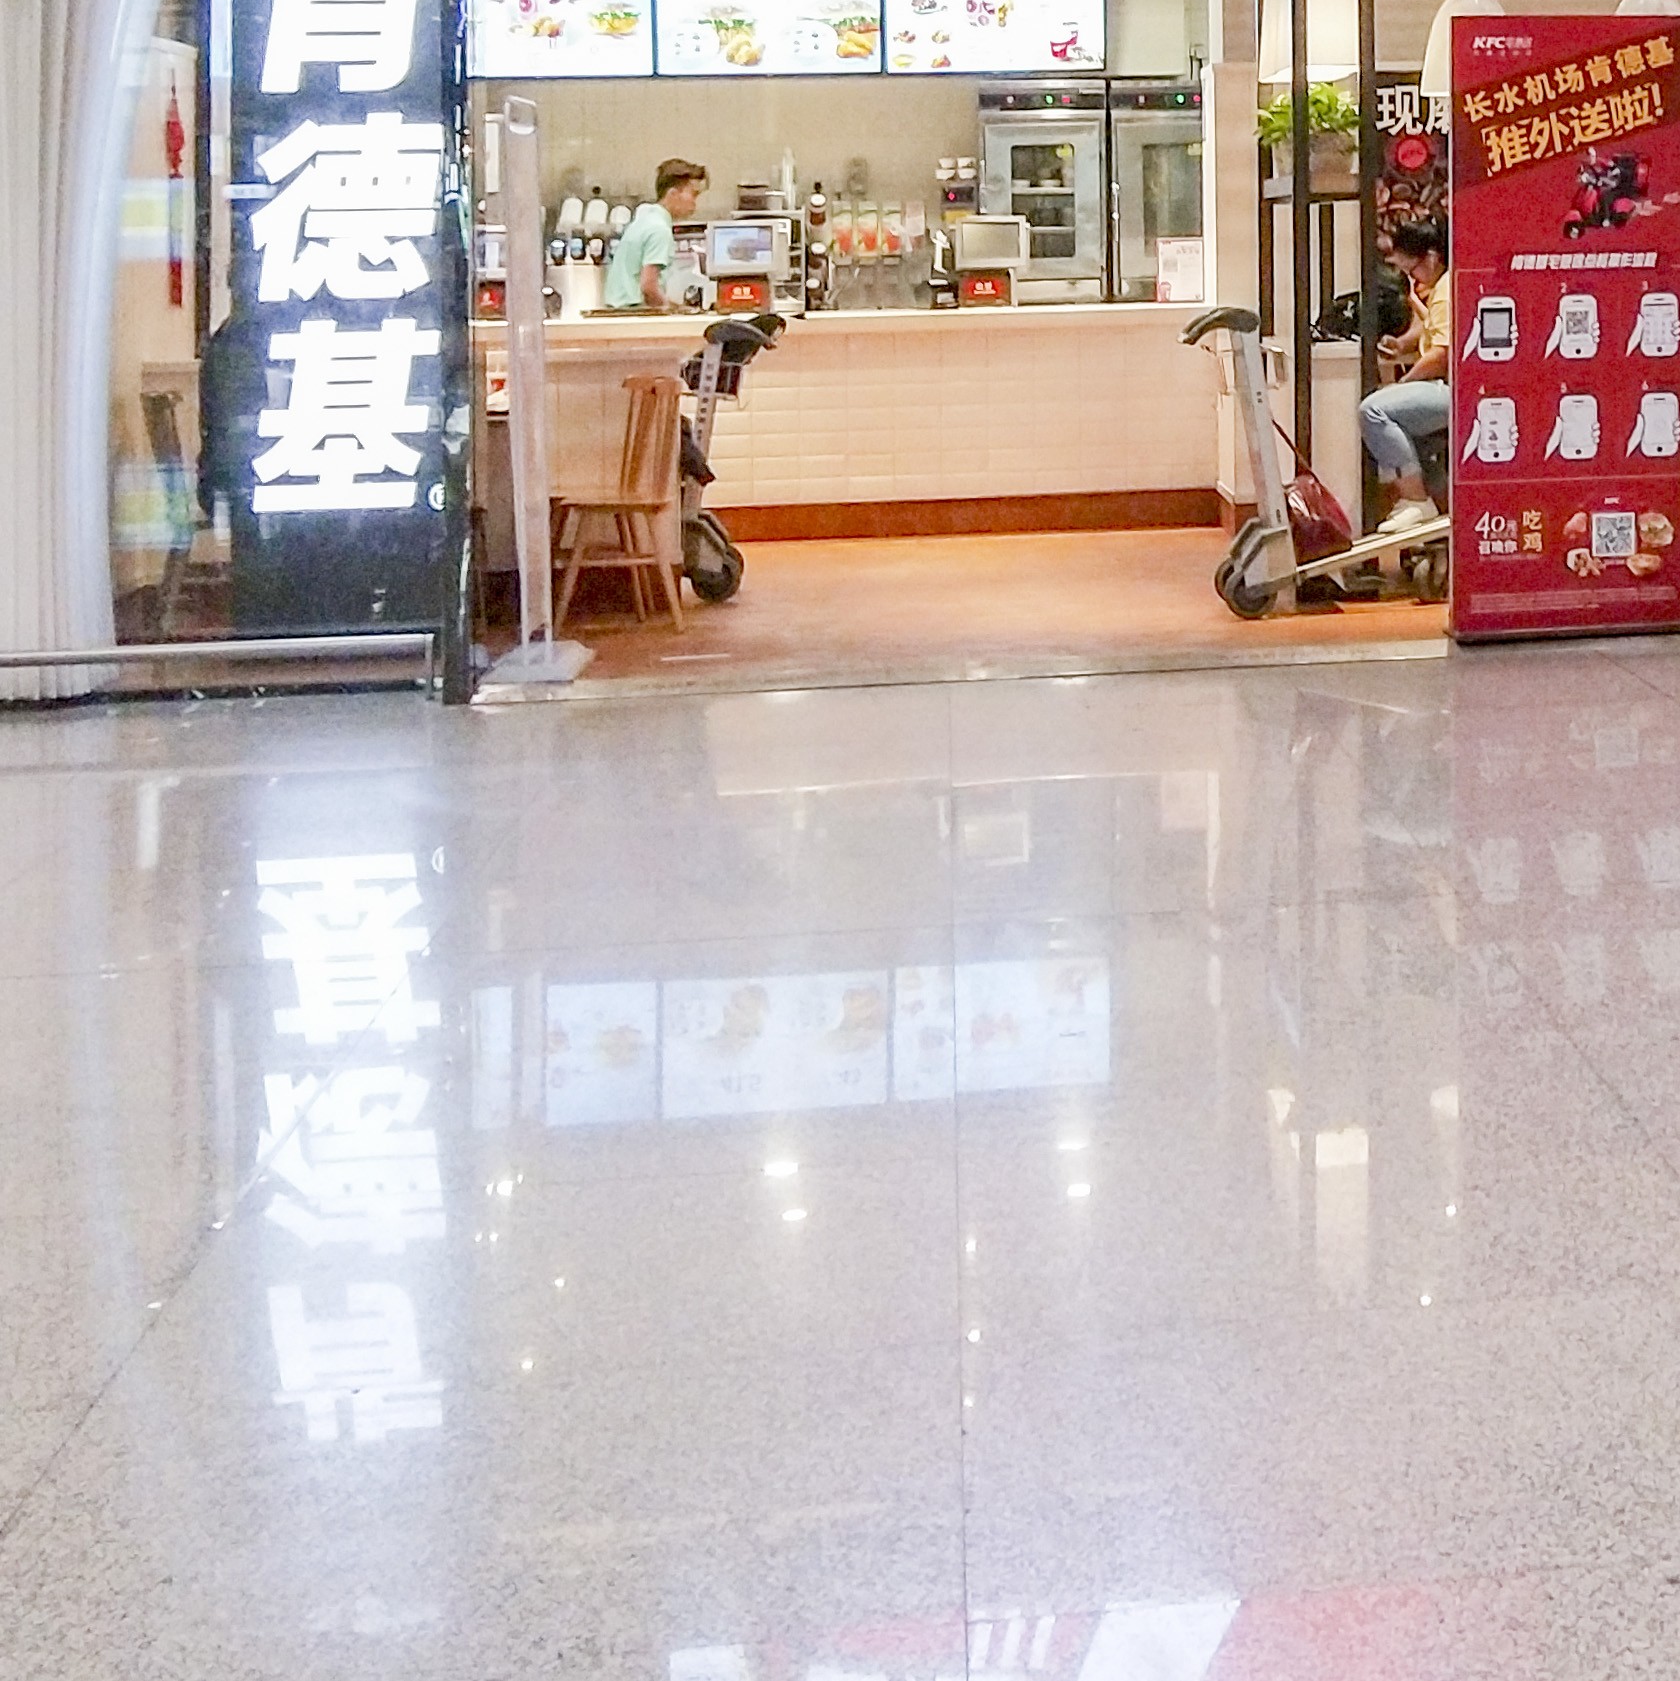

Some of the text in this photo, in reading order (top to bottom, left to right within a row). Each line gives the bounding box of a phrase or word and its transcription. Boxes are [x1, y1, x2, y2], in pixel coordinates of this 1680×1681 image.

[1464, 36, 1675, 122] 长水机场肯德基
